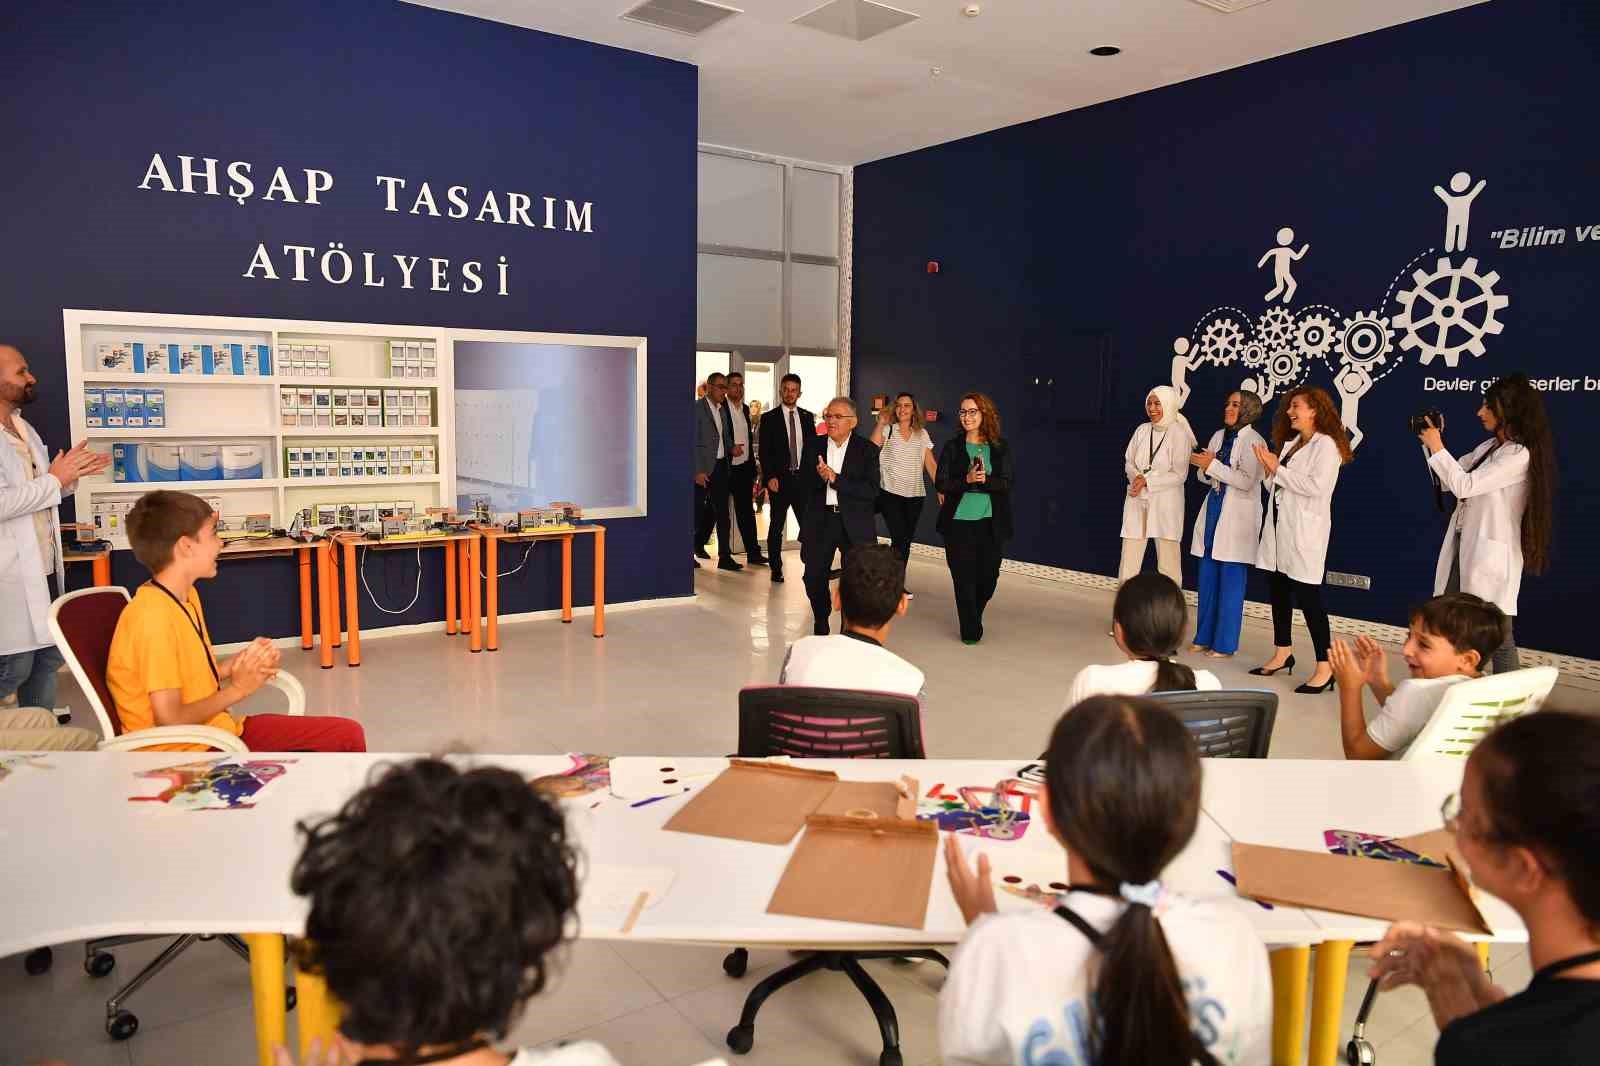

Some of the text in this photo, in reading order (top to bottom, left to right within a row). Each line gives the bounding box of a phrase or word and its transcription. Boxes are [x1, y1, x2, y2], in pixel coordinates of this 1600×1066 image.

[137, 152, 595, 233] AHŞAP TASARIM
[1575, 224, 1600, 243] ve
[243, 241, 510, 296] ATÖLYESİ
[1423, 377, 1476, 391] Devler
